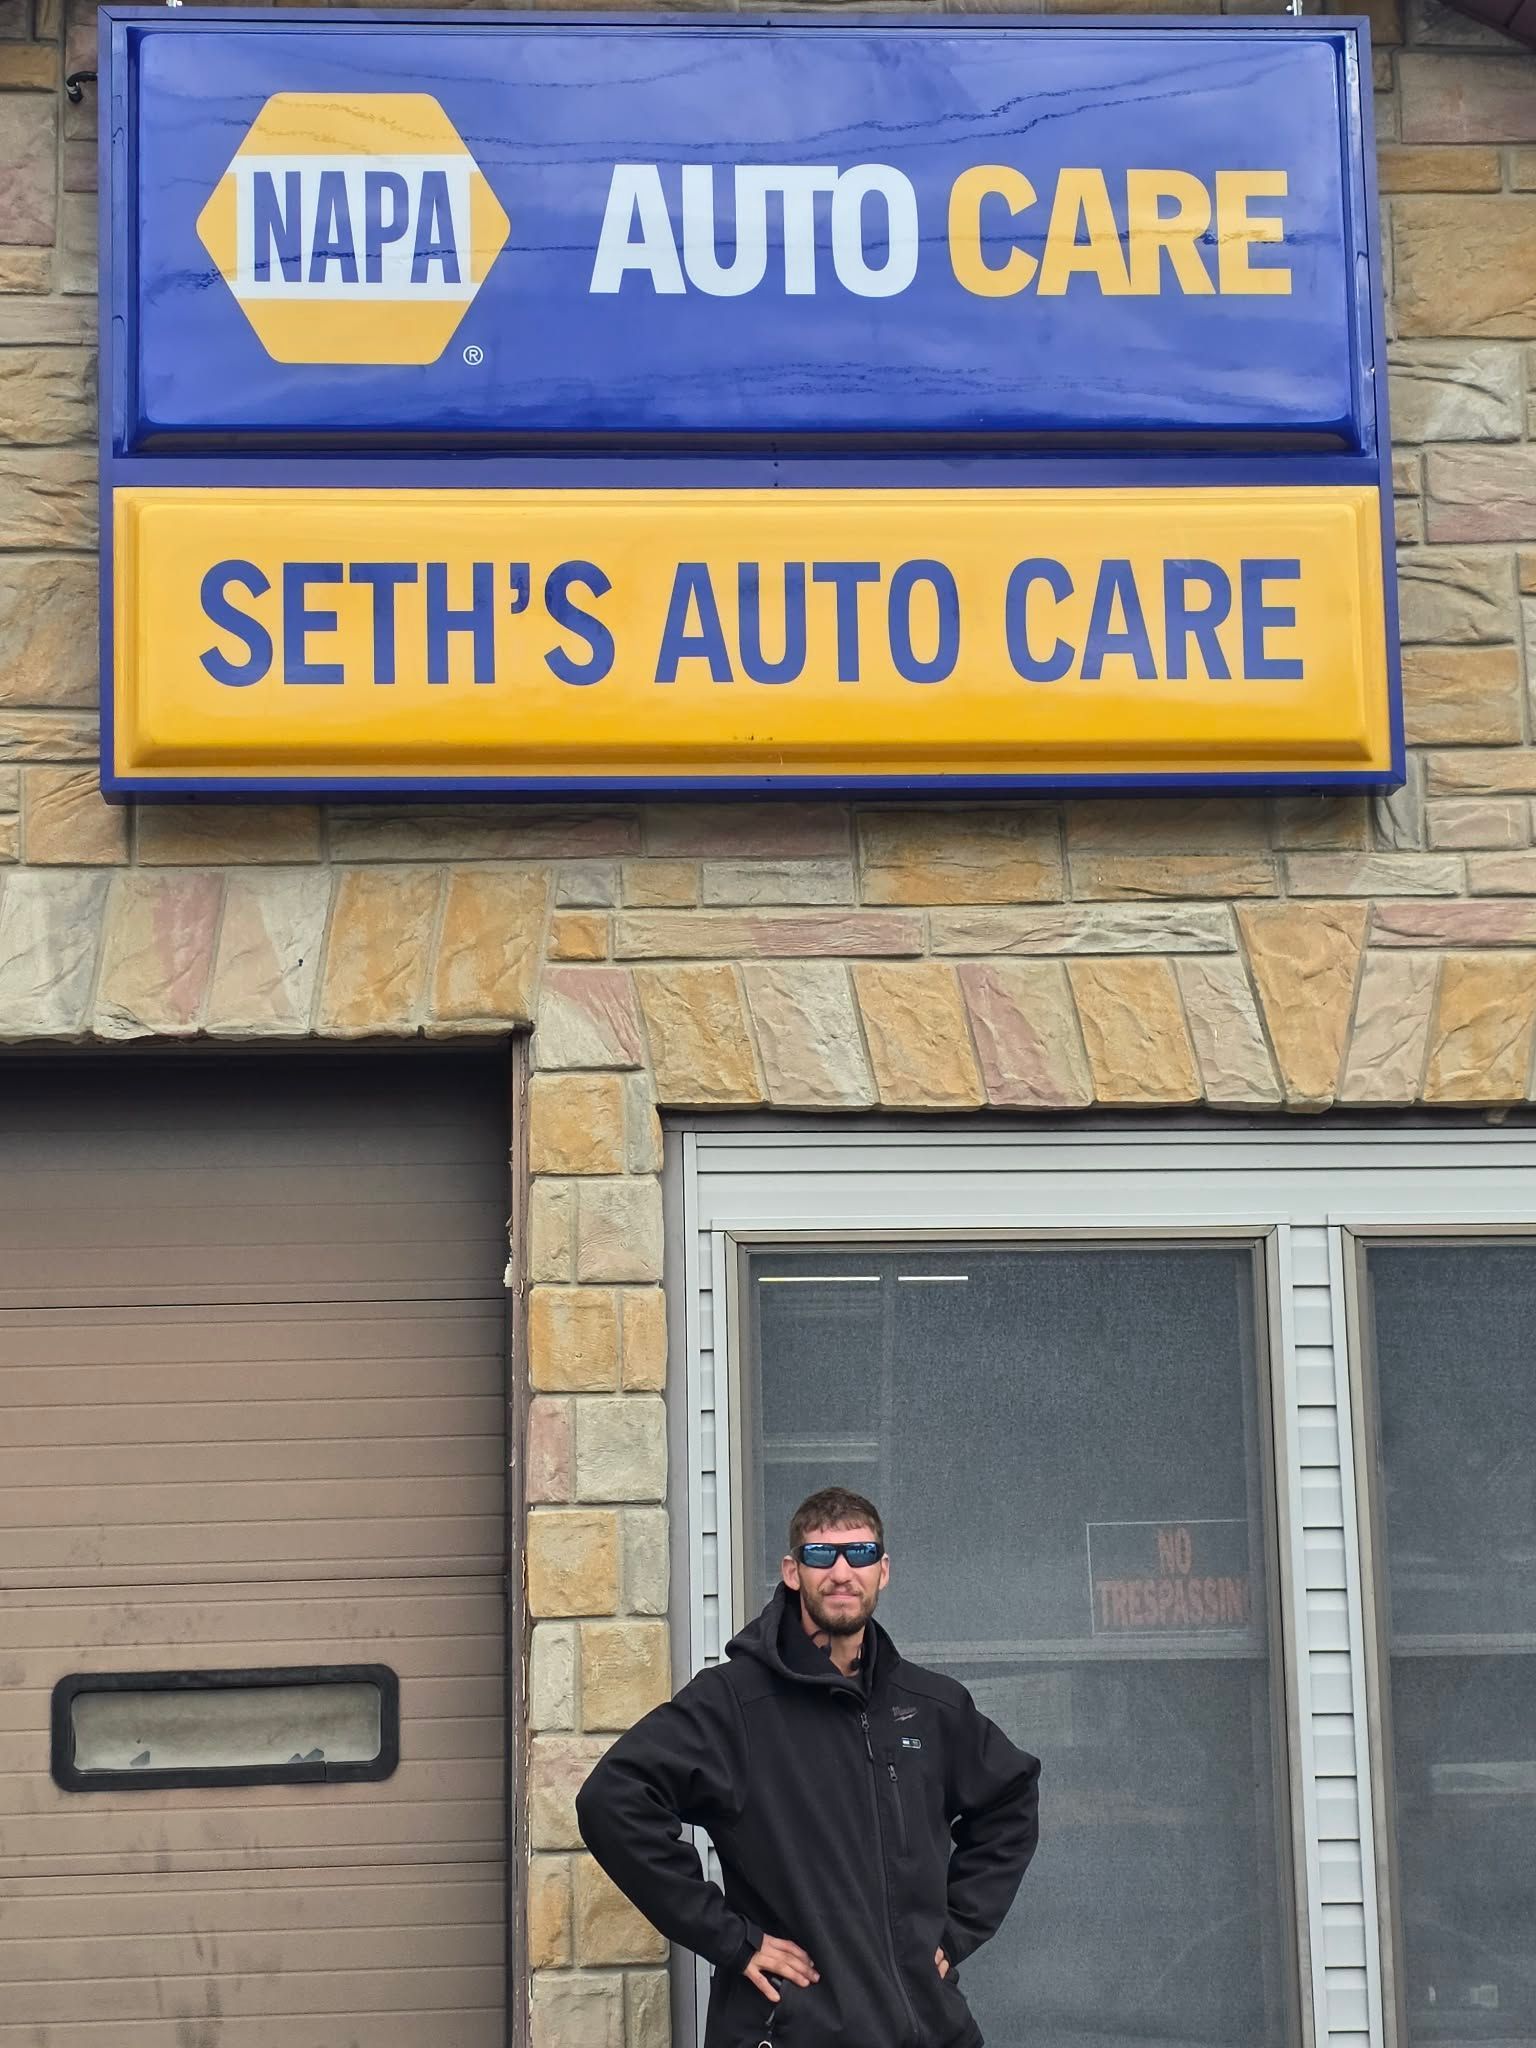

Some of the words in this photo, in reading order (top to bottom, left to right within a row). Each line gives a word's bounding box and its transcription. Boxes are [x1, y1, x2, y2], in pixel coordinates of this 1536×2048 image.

[253, 170, 462, 284] NAPA
[589, 163, 919, 298] AUTO
[948, 164, 1292, 298] CARE
[199, 558, 616, 688] SETH'S
[654, 558, 960, 686] AUTO
[1005, 557, 1304, 684] CARE
[1157, 1527, 1192, 1576] NO
[1096, 1577, 1249, 1626] TRESPASSIN
